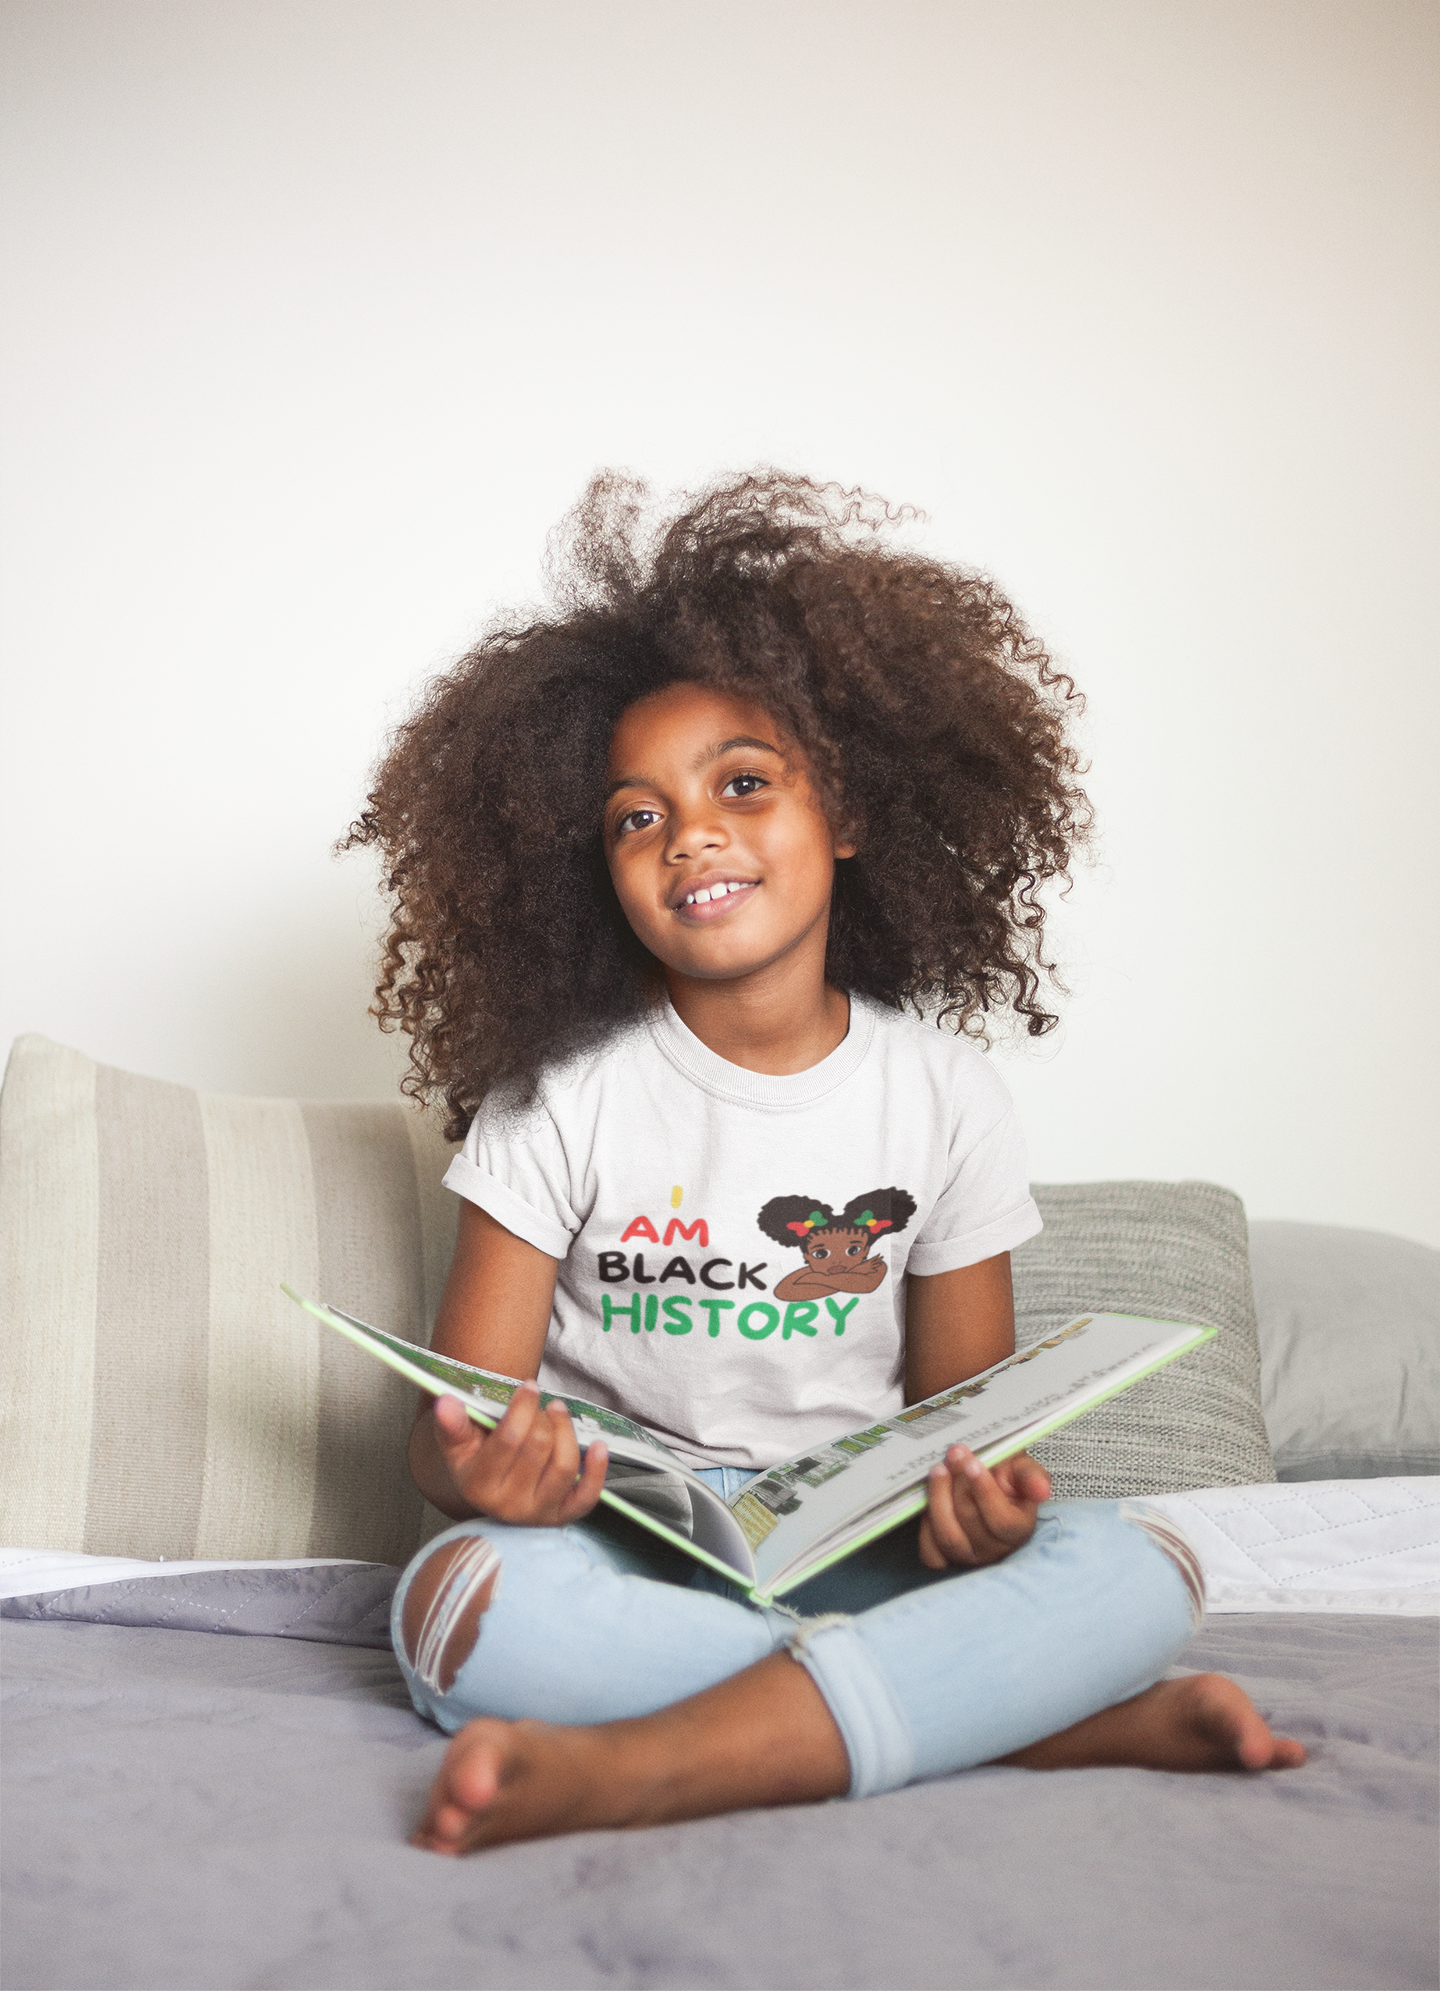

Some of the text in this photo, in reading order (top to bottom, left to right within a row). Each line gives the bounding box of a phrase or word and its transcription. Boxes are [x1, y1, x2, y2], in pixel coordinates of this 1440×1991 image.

[670, 1185, 684, 1209] I
[620, 1215, 709, 1248] AM
[597, 1251, 768, 1291] BLACK
[601, 1292, 860, 1341] HISTORY
